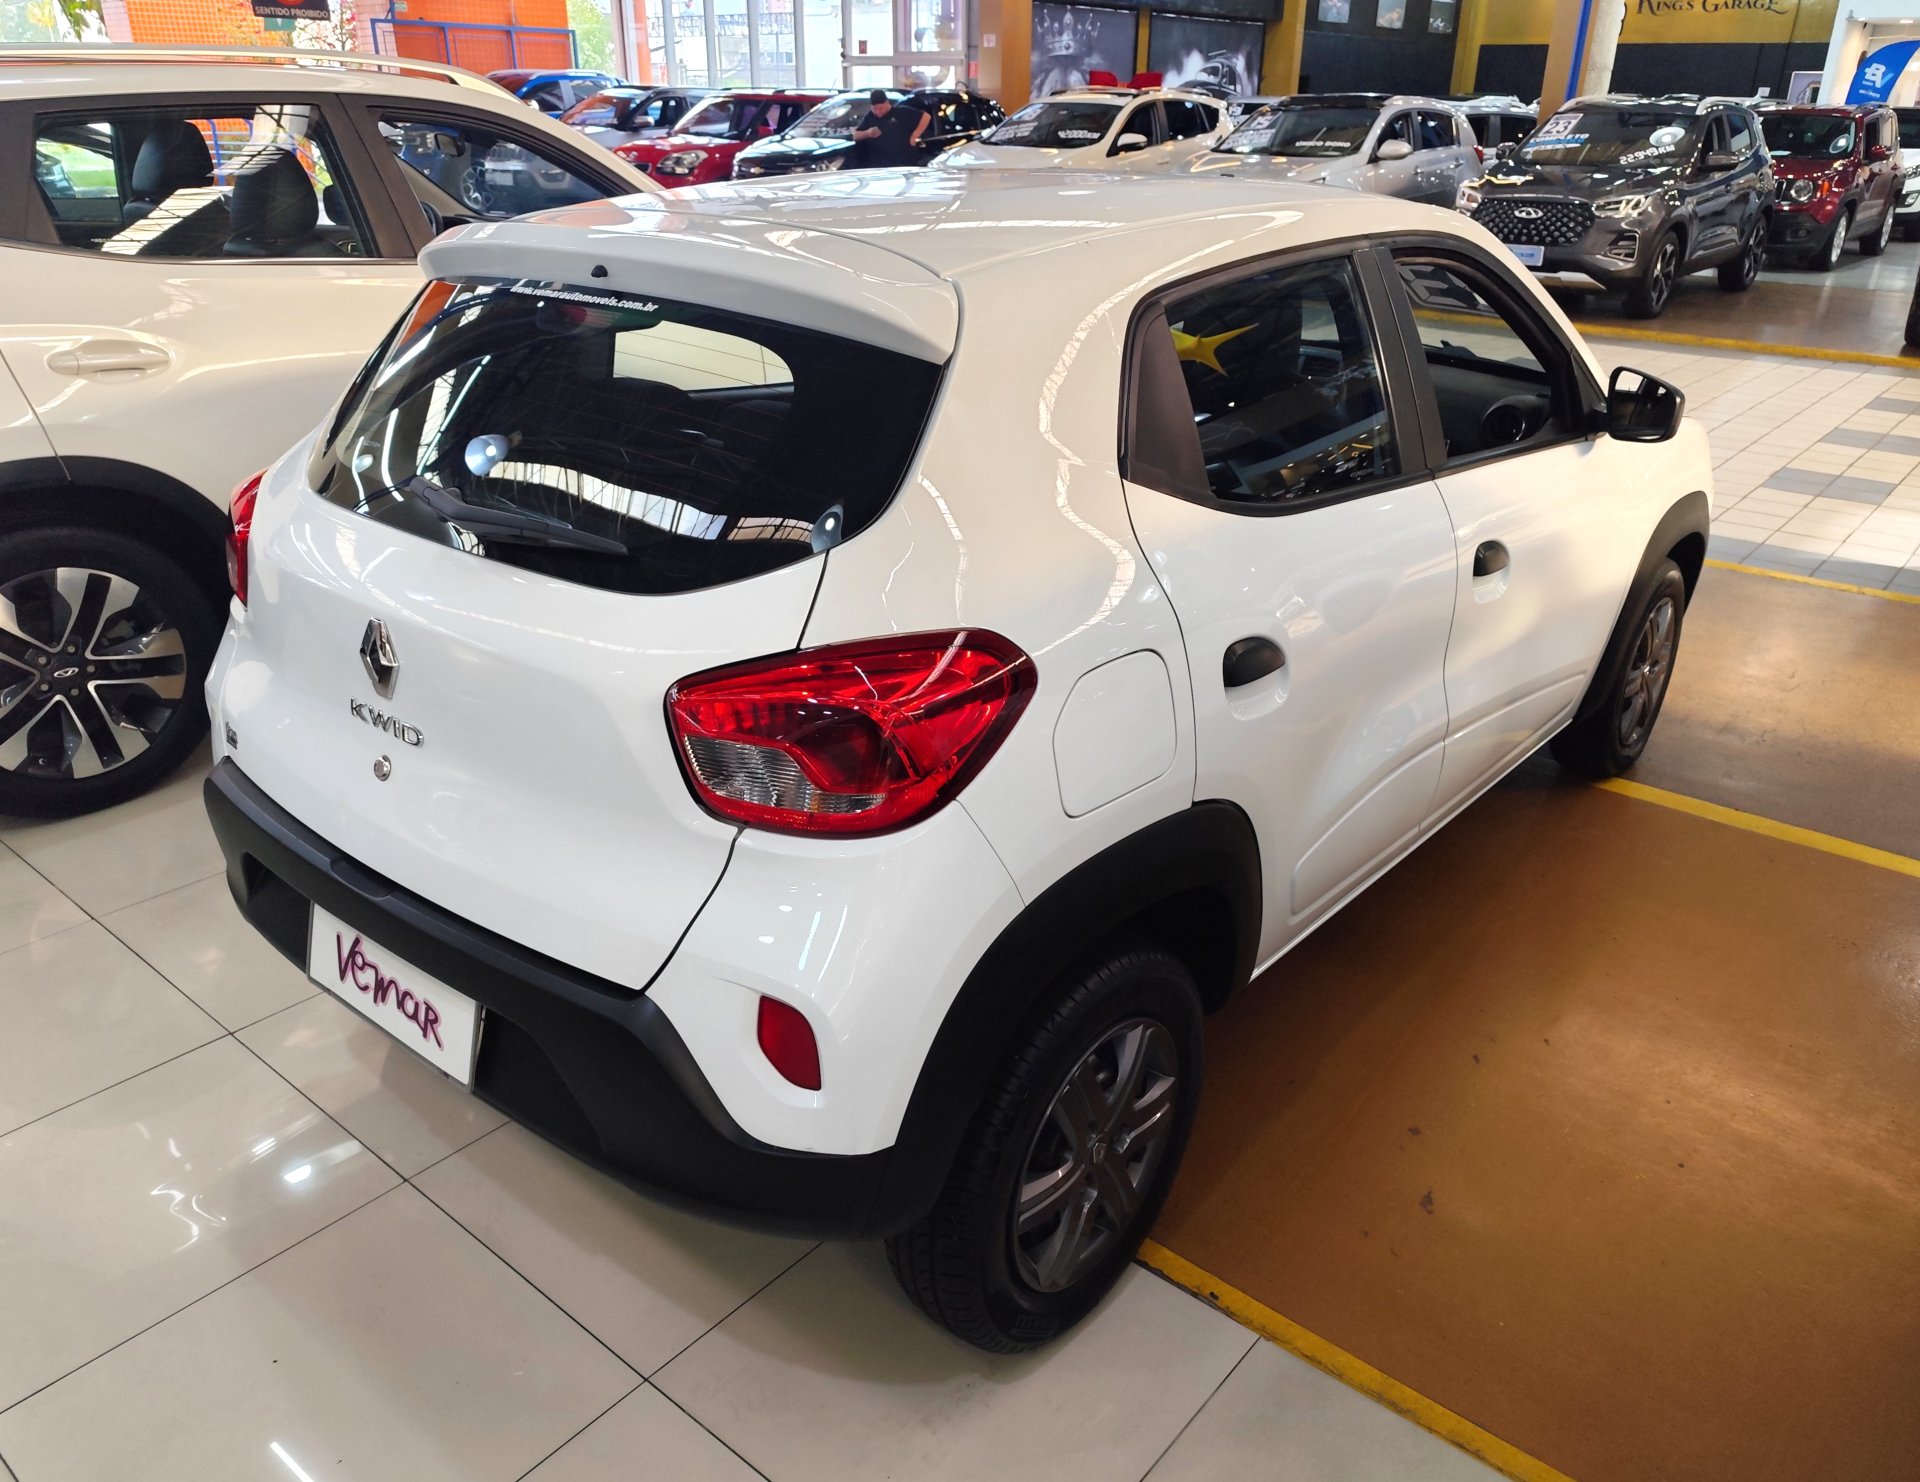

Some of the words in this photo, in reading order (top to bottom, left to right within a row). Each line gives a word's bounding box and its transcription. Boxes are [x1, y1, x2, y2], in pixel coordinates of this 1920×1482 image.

[255, 6, 289, 16] SENTIDO
[290, 8, 328, 18] PROIBIDO
[1542, 121, 1572, 135] 23
[510, 286, 659, 312] www.vemarautomoveis.com.br
[350, 697, 424, 747] KWID
